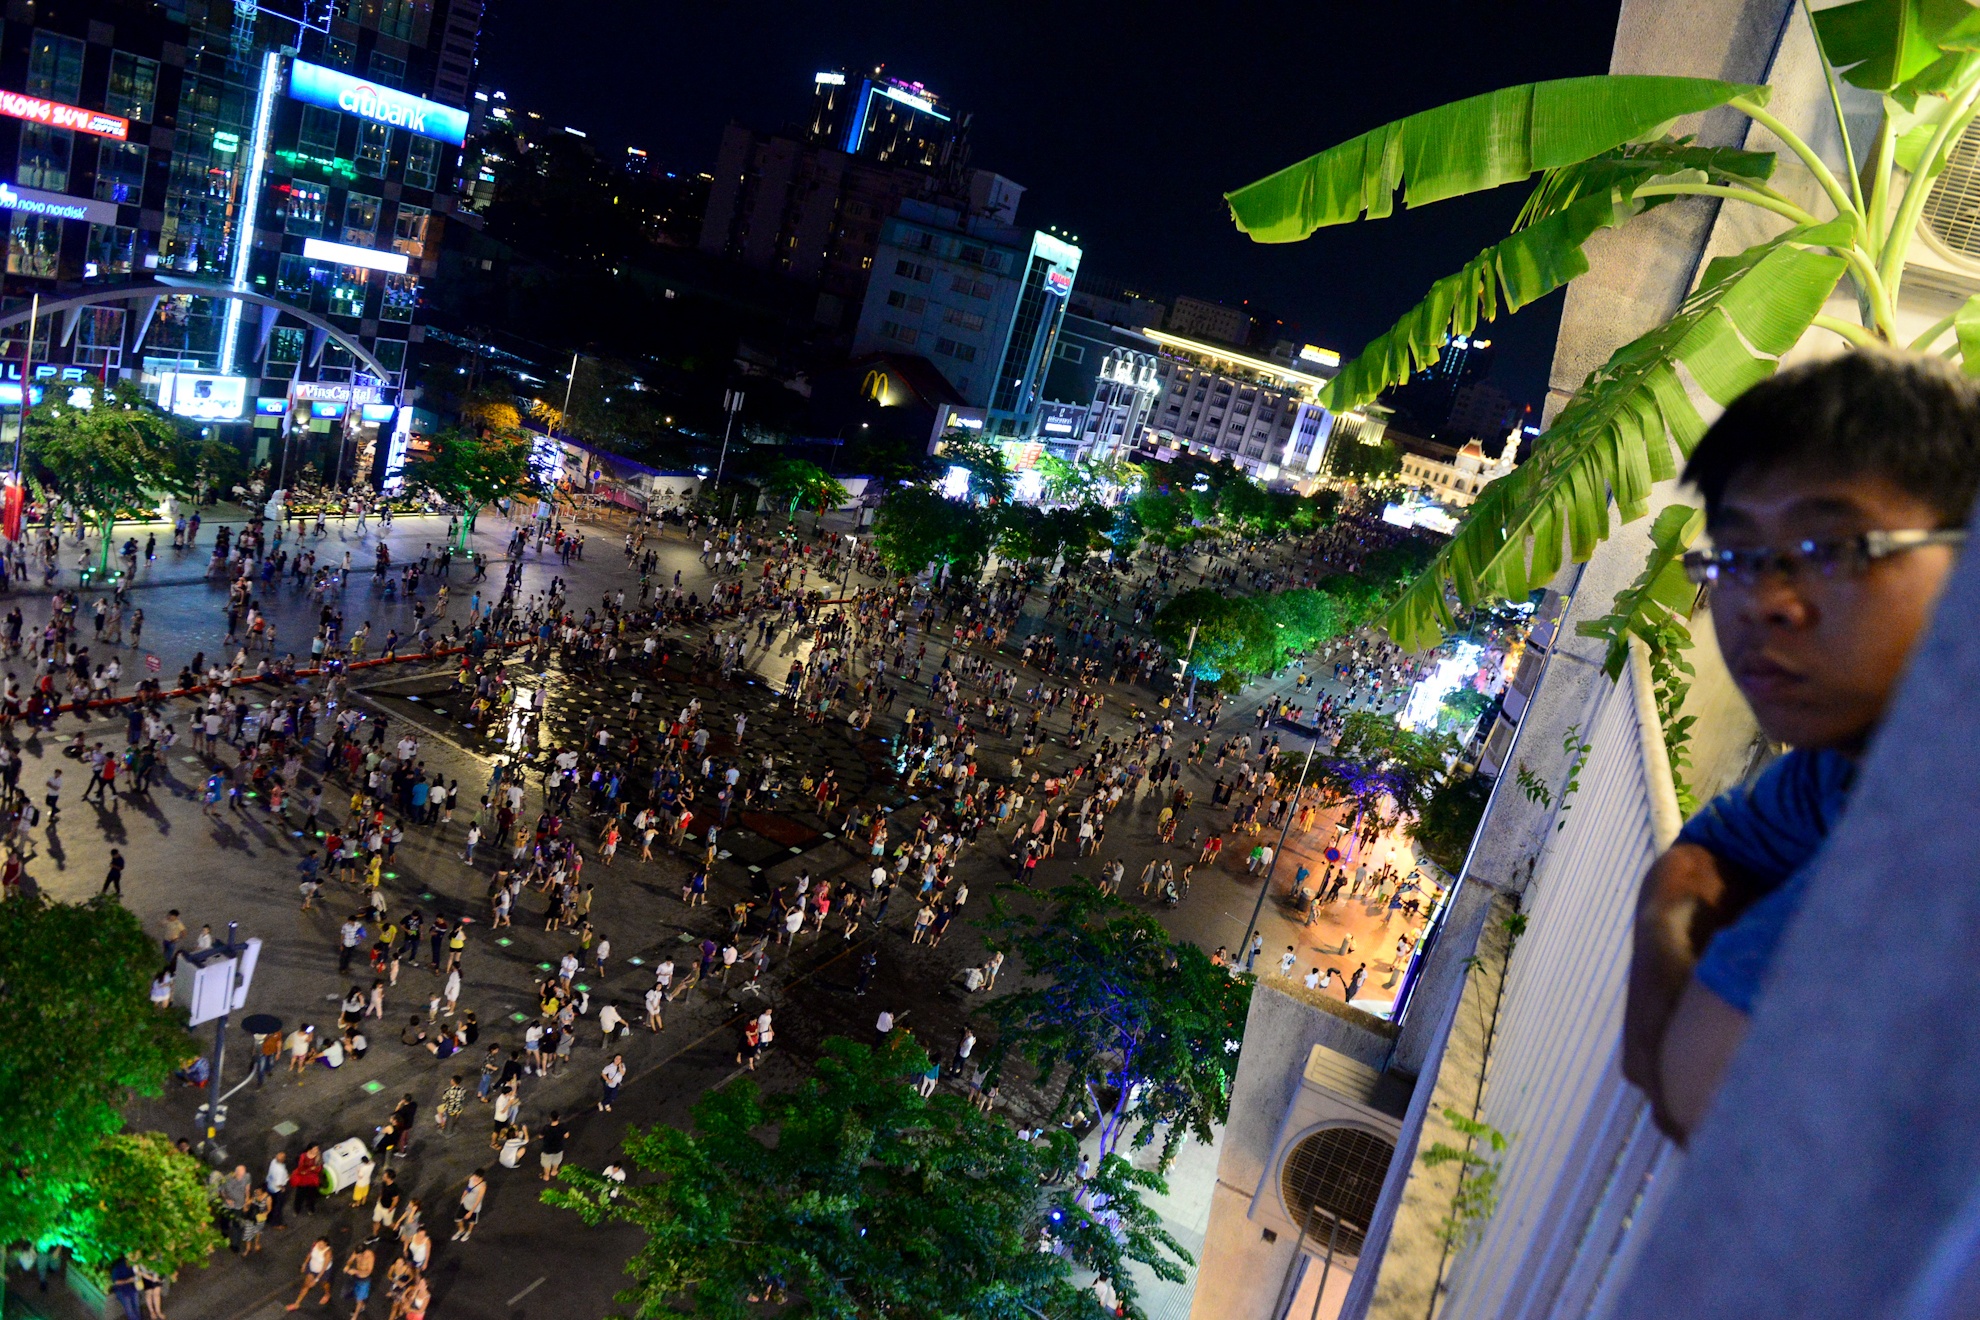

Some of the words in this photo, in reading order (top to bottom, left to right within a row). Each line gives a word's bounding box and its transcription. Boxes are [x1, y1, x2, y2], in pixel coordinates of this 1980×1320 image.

[0, 91, 51, 121] KONG
[338, 86, 427, 133] citibank
[17, 199, 46, 214] novo
[46, 202, 88, 220] nordisk
